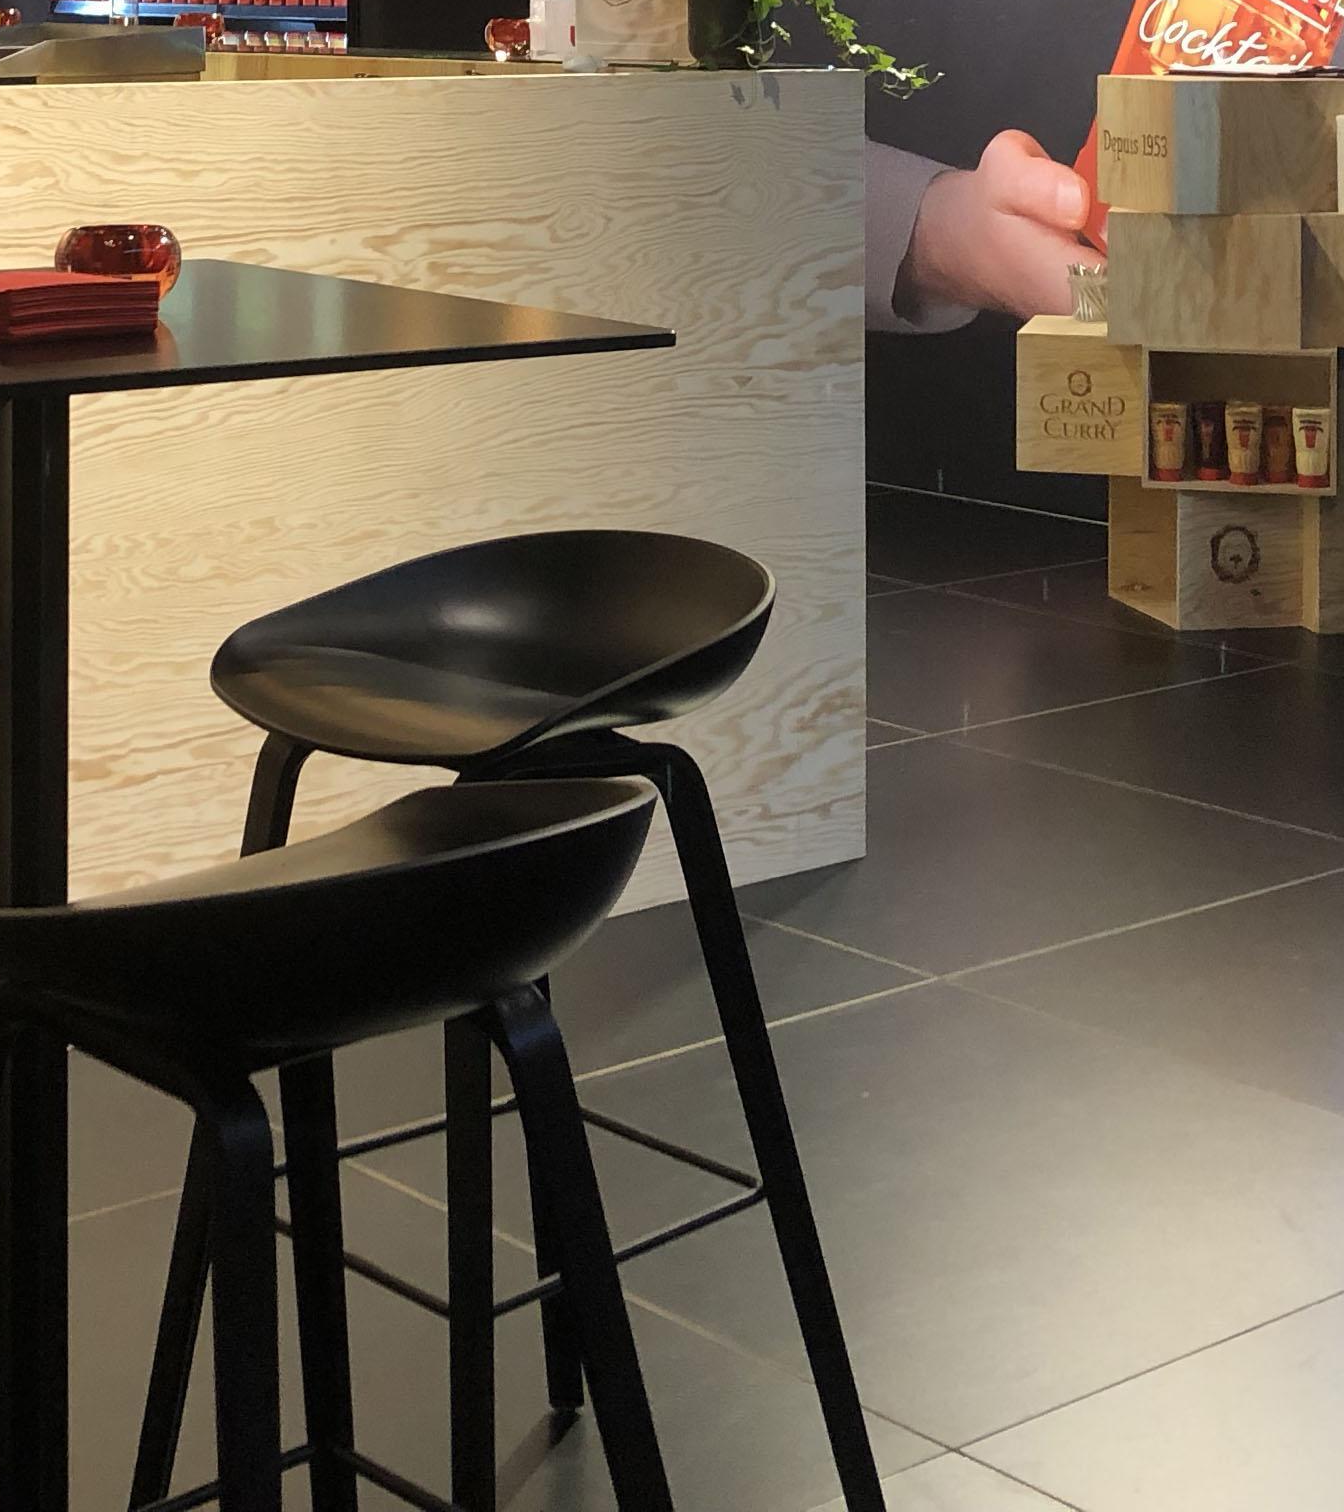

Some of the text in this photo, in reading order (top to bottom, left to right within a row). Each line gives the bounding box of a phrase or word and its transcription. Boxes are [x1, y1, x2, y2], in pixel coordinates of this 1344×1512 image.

[1103, 129, 1168, 161] Depuis 1953
[1039, 392, 1126, 417] GRAND
[1044, 417, 1122, 441] CURRY
